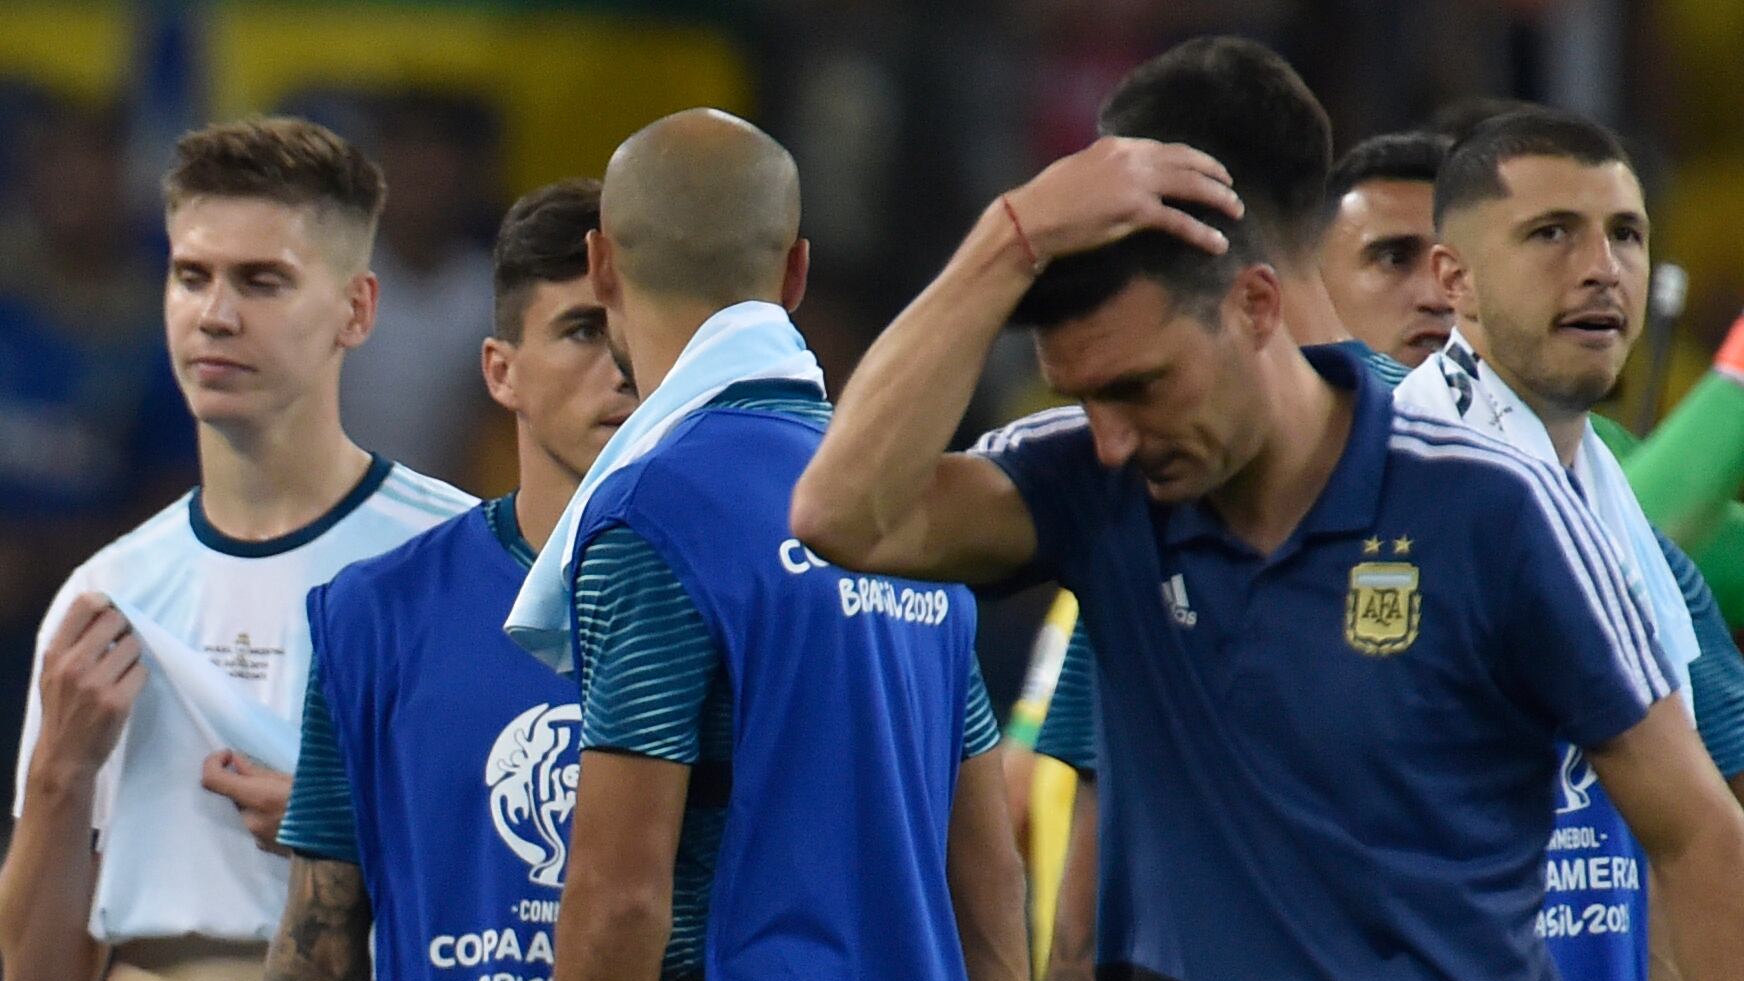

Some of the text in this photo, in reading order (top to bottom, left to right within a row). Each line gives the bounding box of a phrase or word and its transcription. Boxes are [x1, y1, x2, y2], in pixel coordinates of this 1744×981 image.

[901, 588, 949, 625] 2019
[1362, 588, 1403, 626] AFA
[1582, 903, 1630, 934] 201
[429, 928, 522, 967] COPA
